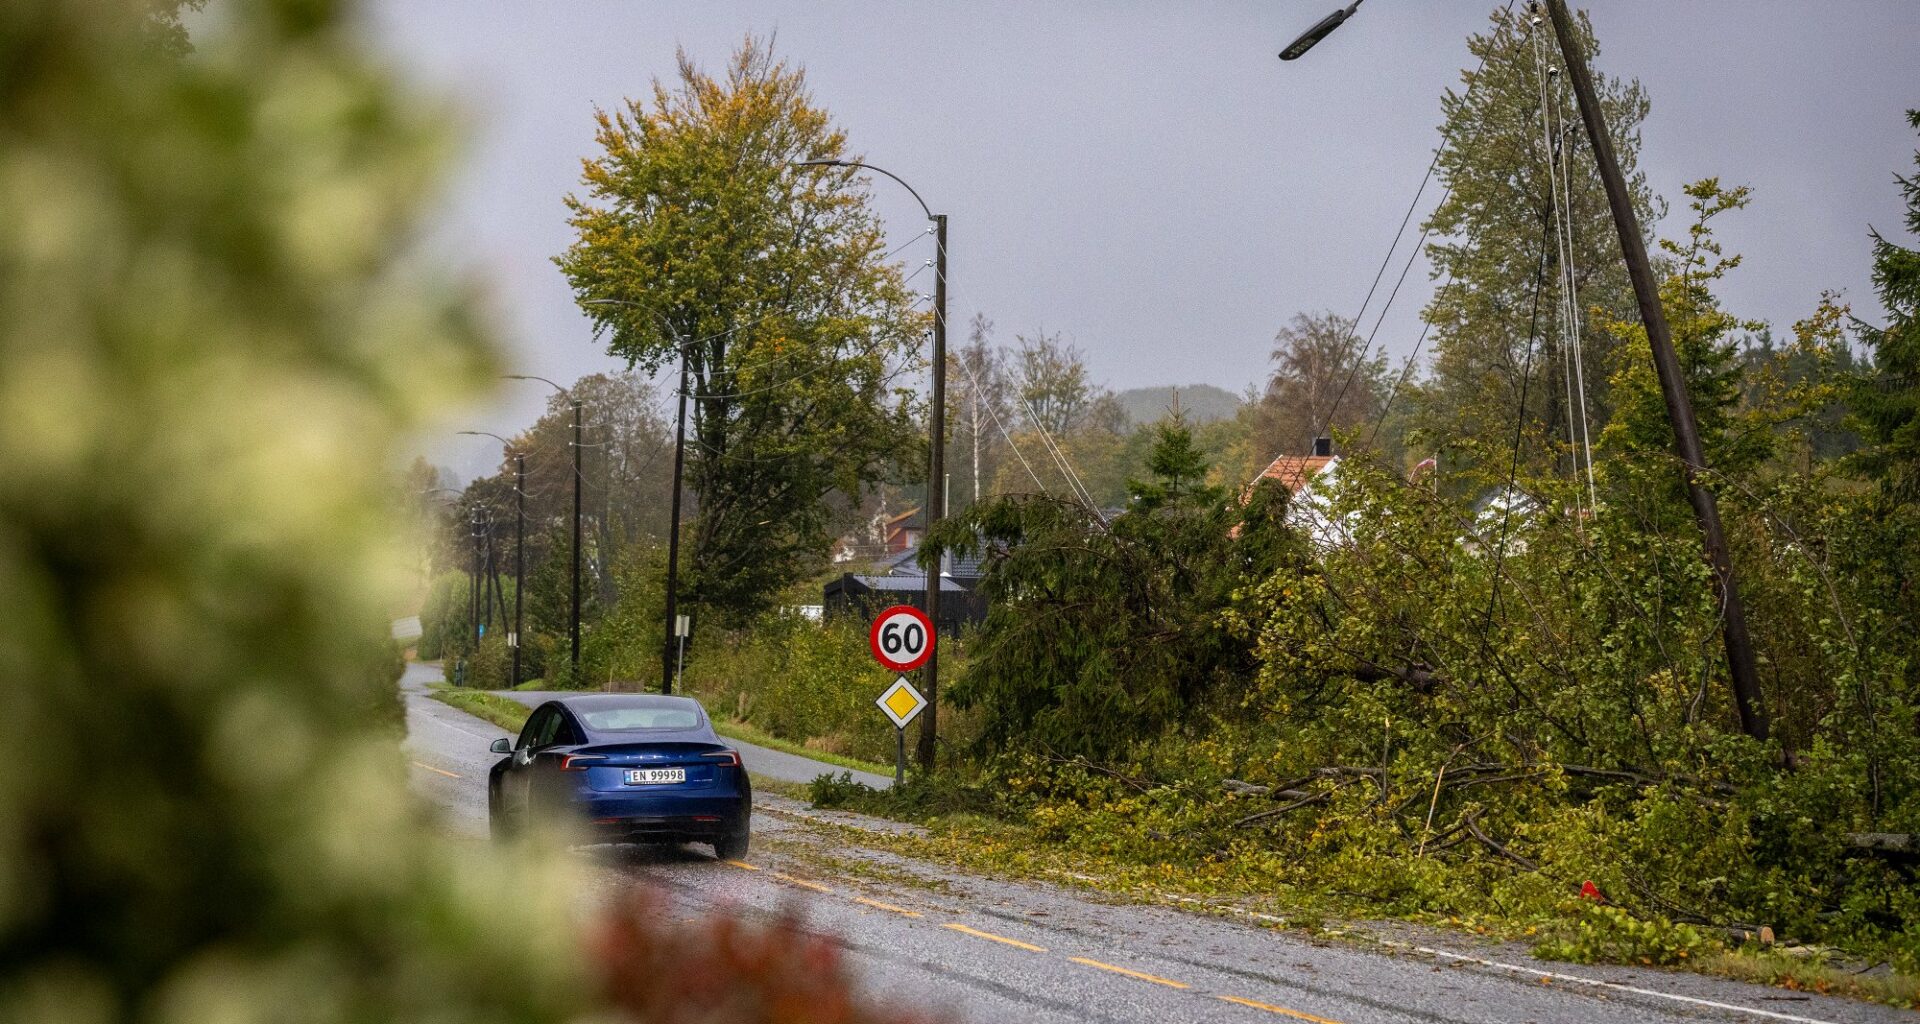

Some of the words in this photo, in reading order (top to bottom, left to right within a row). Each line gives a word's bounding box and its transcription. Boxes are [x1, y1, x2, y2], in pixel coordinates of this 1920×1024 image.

[882, 622, 923, 654] 60
[632, 771, 646, 781] EN
[650, 770, 684, 780] 99998
